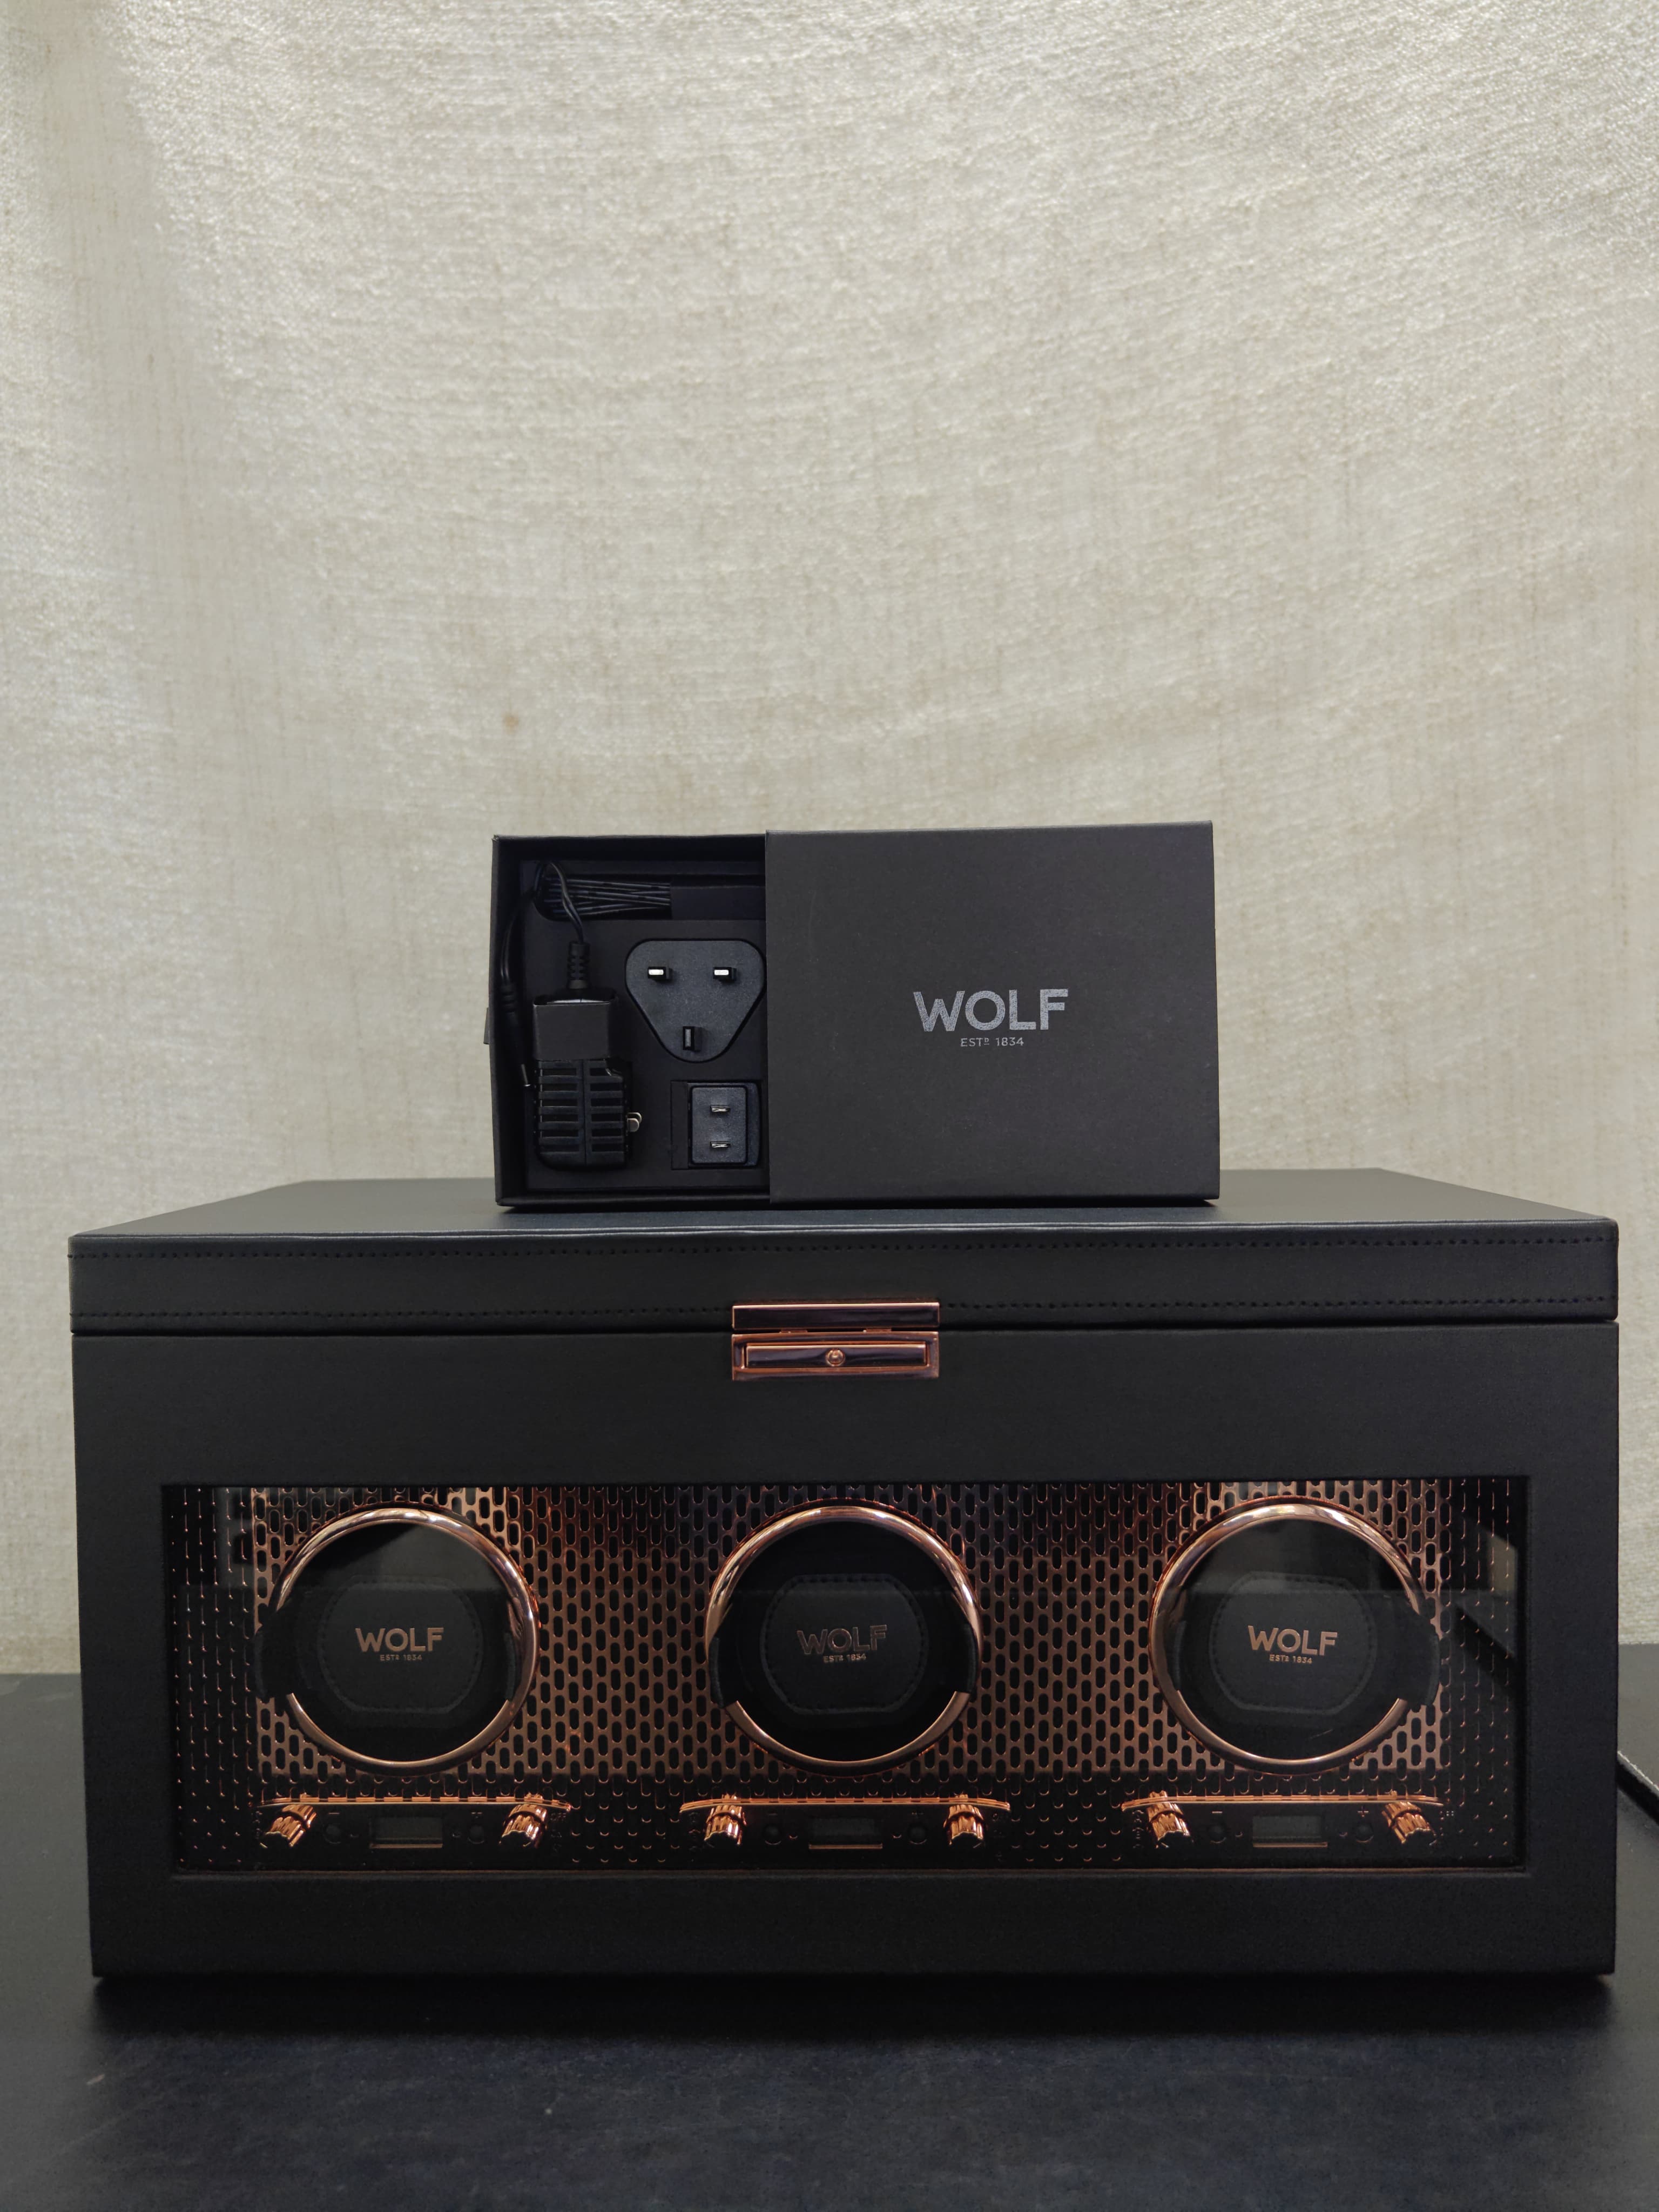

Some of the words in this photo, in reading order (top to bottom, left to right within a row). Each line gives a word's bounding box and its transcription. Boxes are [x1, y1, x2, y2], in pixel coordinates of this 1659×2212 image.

[913, 989, 1069, 1032] WOLF
[996, 1037, 1024, 1046] 1834
[355, 1627, 444, 1652] WOLF
[796, 1624, 887, 1655] WOLF
[1247, 1625, 1338, 1656] WOLF
[1292, 1656, 1313, 1664] 1834
